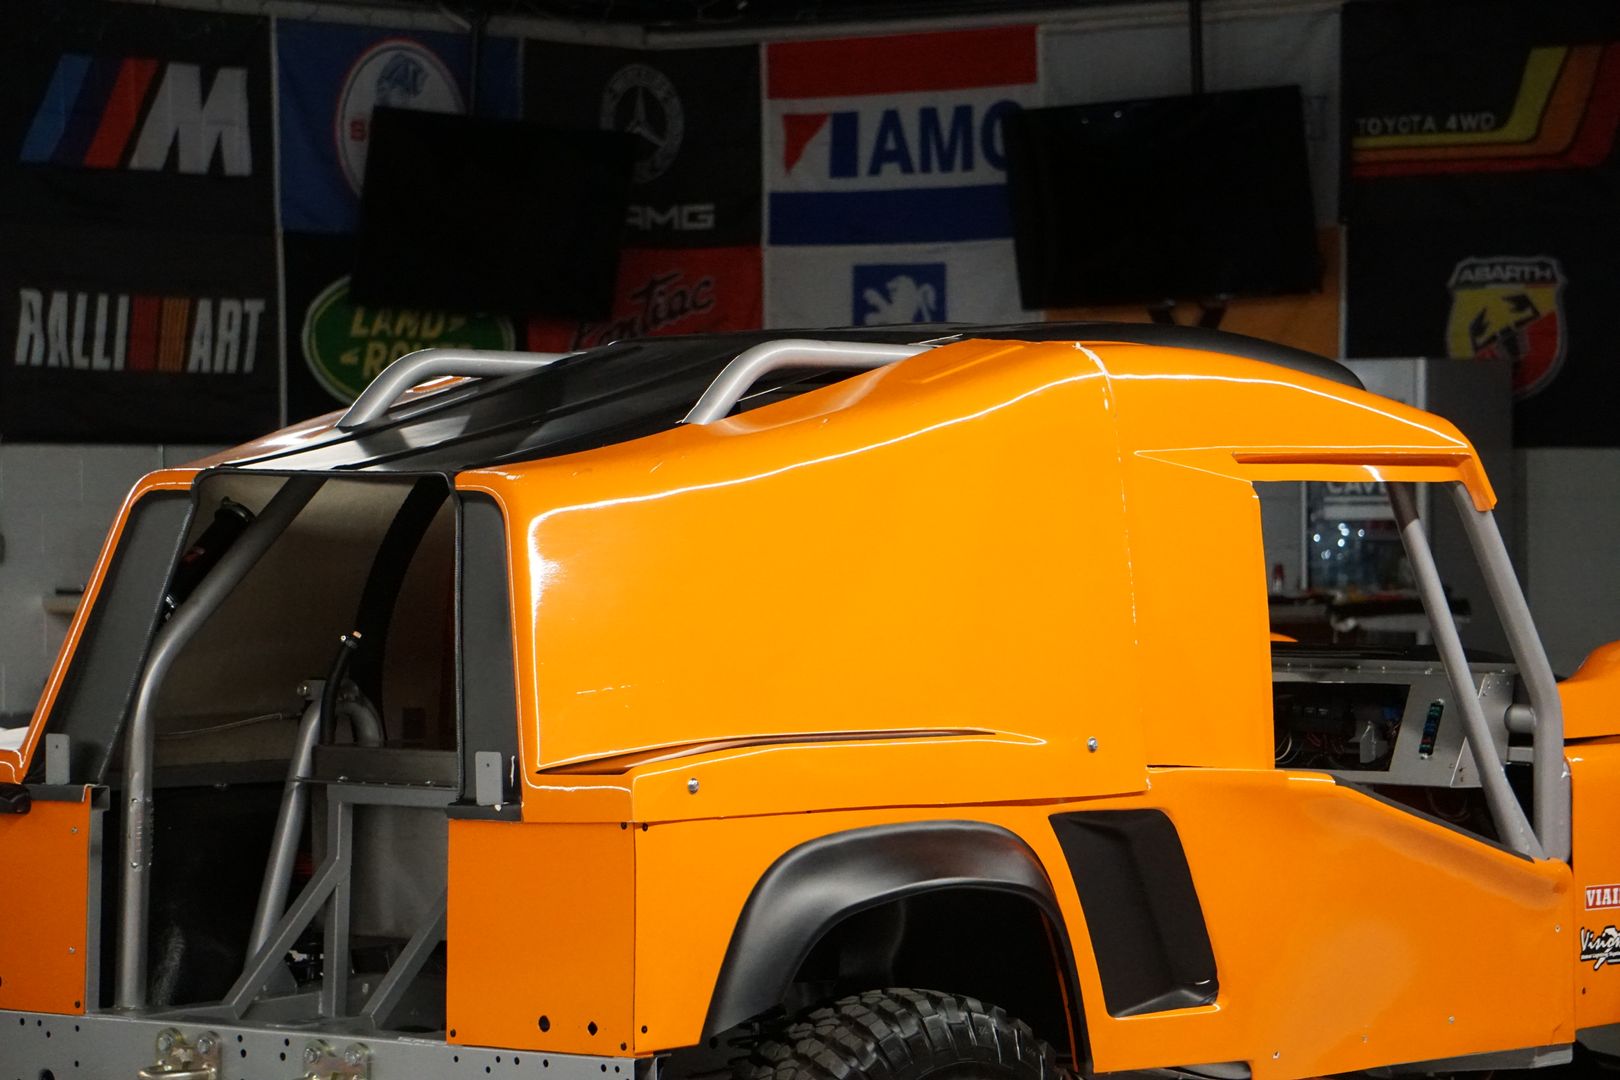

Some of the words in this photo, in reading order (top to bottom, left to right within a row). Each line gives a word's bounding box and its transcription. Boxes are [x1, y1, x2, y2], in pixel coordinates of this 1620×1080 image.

[1357, 114, 1438, 135] TOYOTA
[1445, 111, 1497, 132] 4WD
[1459, 264, 1553, 283] ABARTH
[1586, 887, 1620, 907] VIAI
